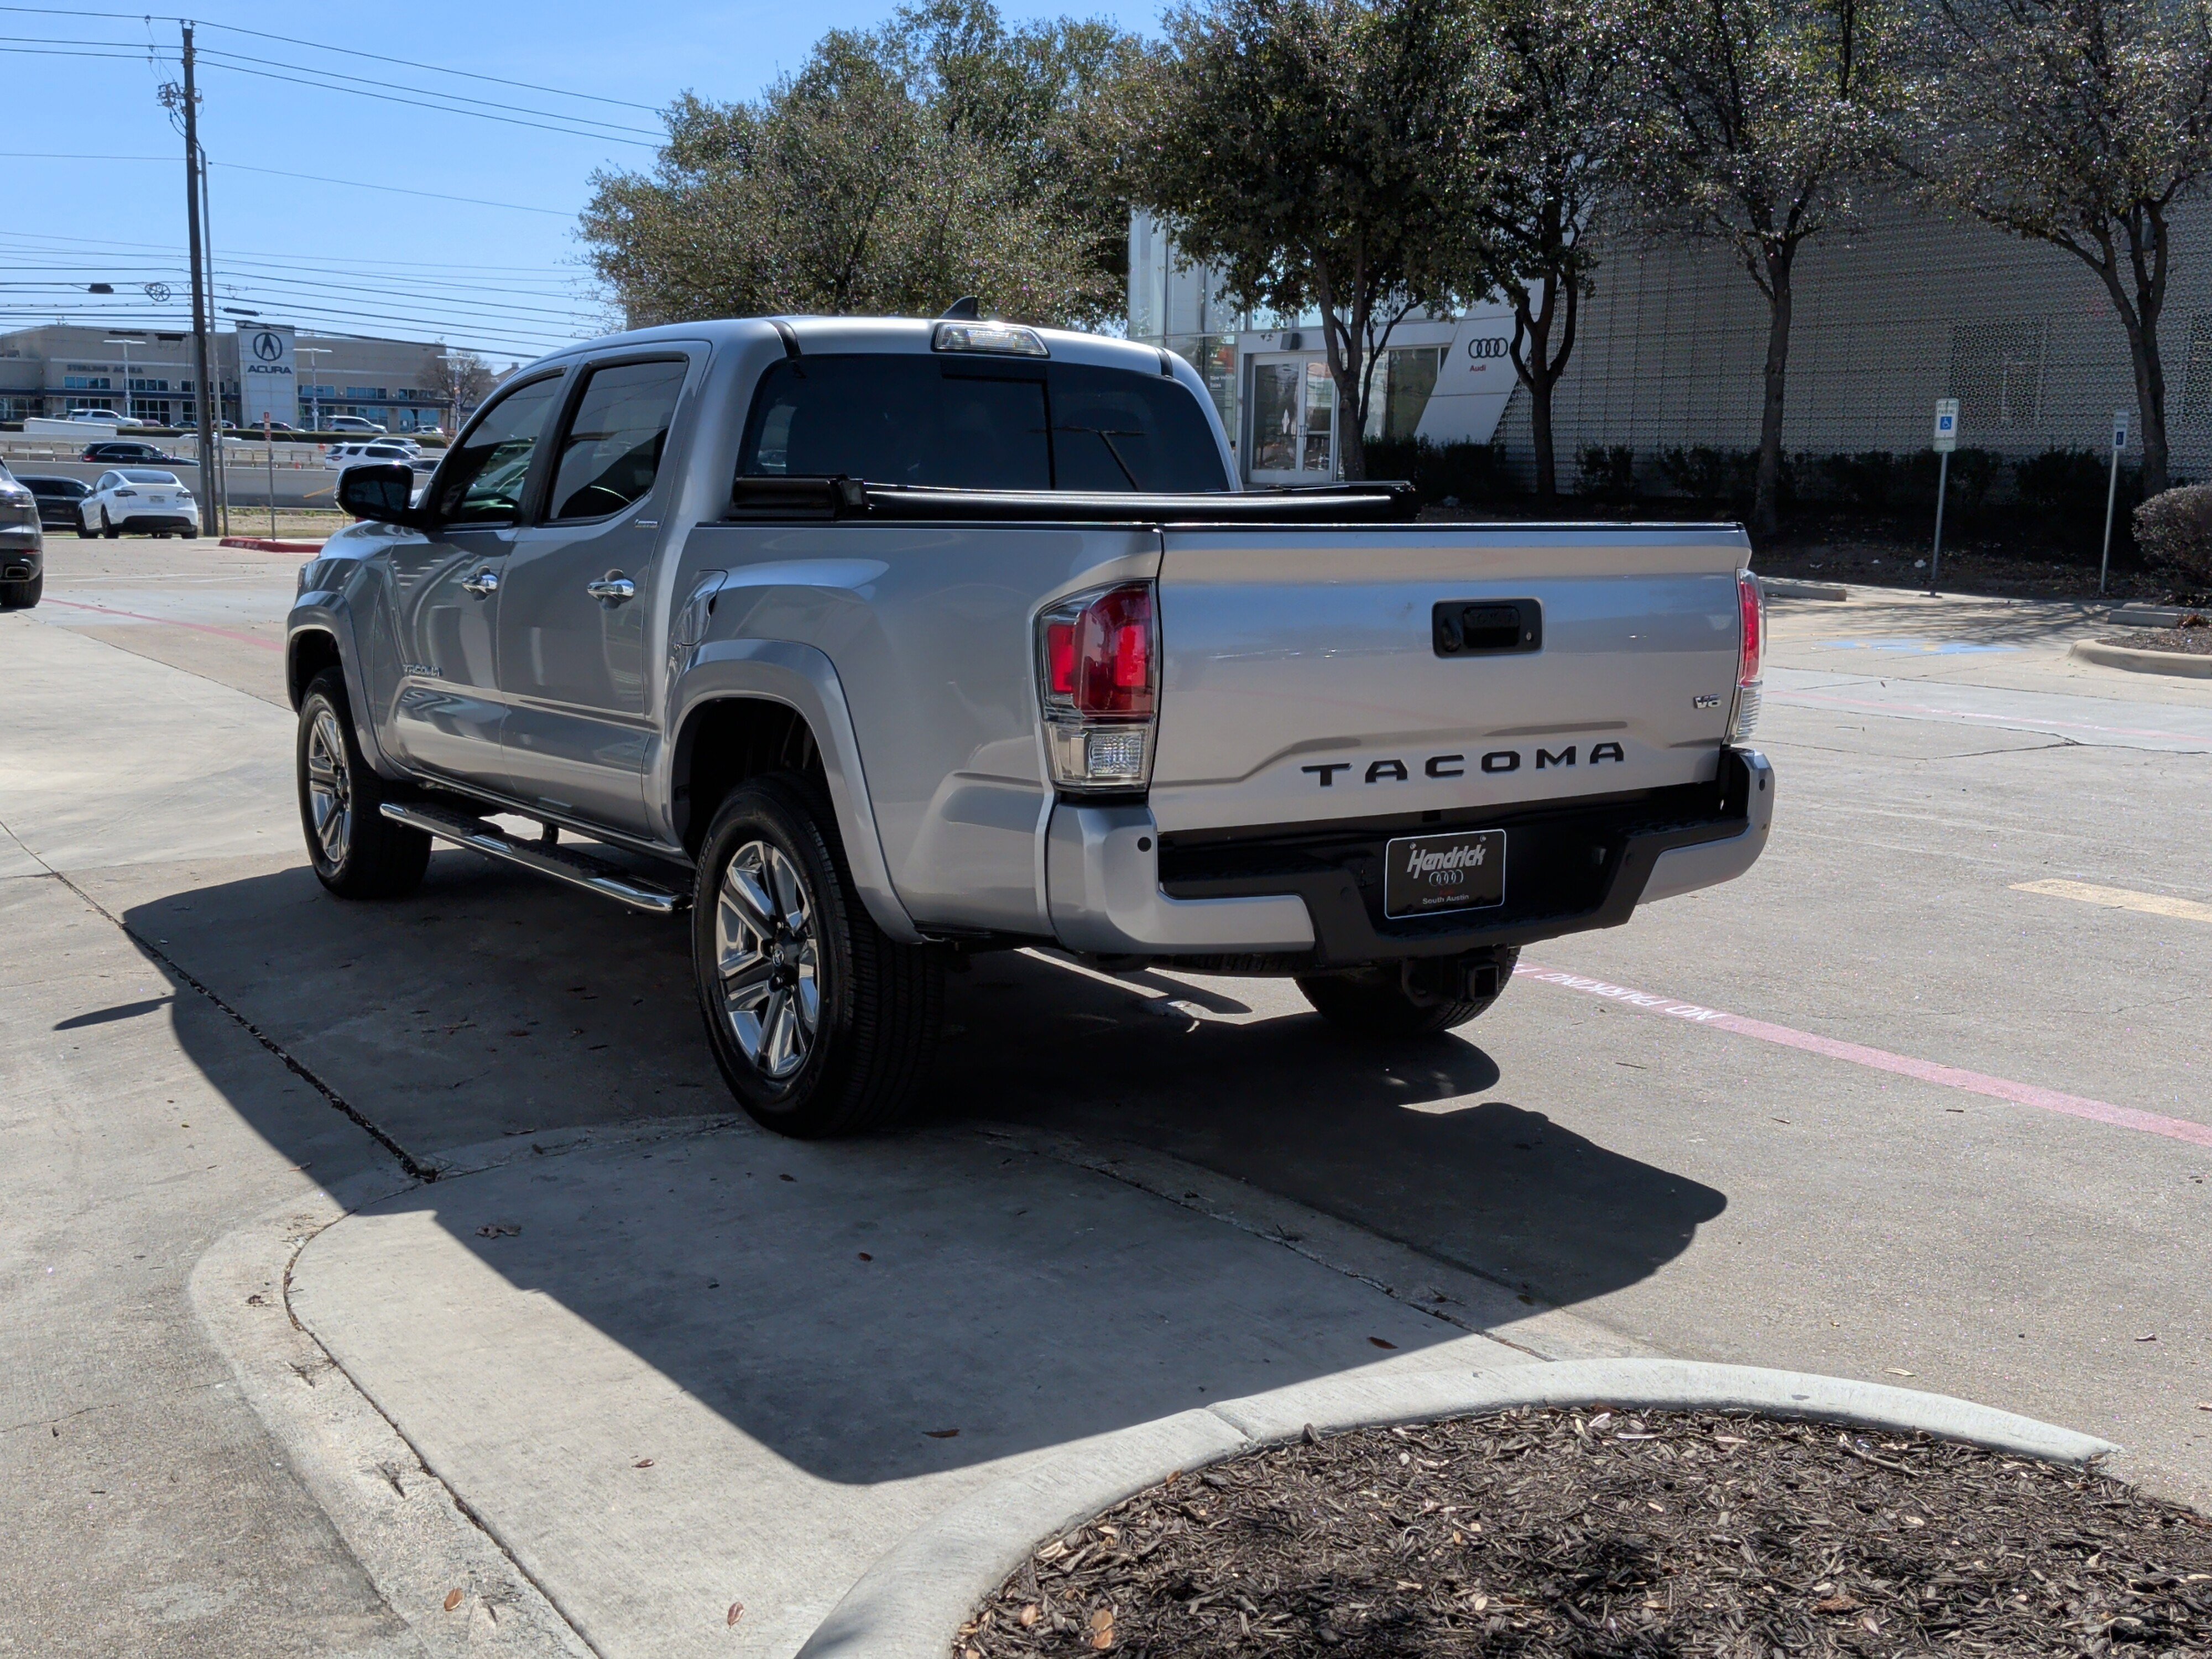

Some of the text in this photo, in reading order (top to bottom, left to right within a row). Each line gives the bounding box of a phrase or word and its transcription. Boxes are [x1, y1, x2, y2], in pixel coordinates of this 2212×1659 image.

[66, 364, 108, 373] STERLING
[247, 365, 293, 374] ACURA
[1693, 694, 1721, 709] V6
[1301, 741, 1625, 787] TACOMA
[1406, 844, 1487, 879] Hendrick
[1422, 894, 1469, 905] South Austin
[1533, 972, 1727, 1021] NO PARKING
